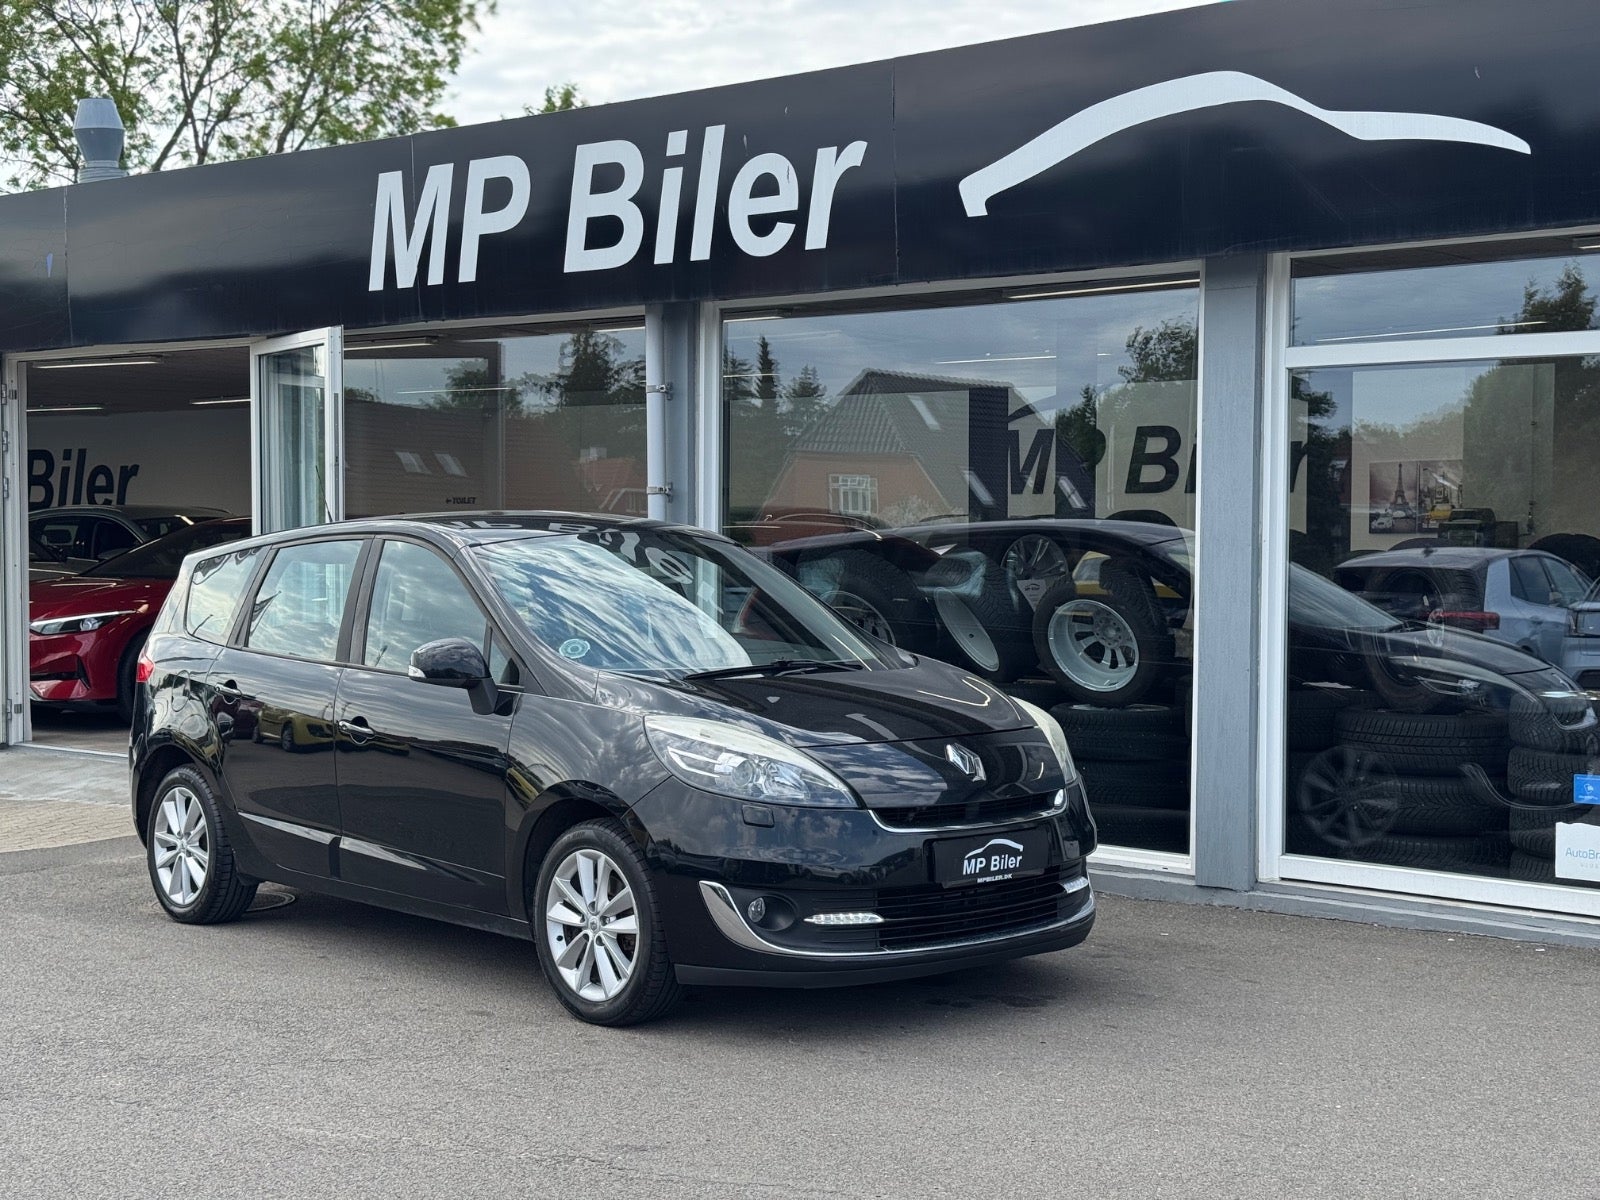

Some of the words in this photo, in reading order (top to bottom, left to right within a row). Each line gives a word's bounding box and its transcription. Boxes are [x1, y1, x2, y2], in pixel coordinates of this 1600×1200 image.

[368, 154, 531, 292] MP
[563, 124, 868, 274] Biler
[27, 448, 140, 512] Biler
[452, 496, 477, 505] TOILET
[1565, 847, 1600, 860] AutoBr
[963, 857, 987, 876] MP
[990, 854, 1023, 872] Biler
[976, 873, 1013, 883] MPBILER.DK
